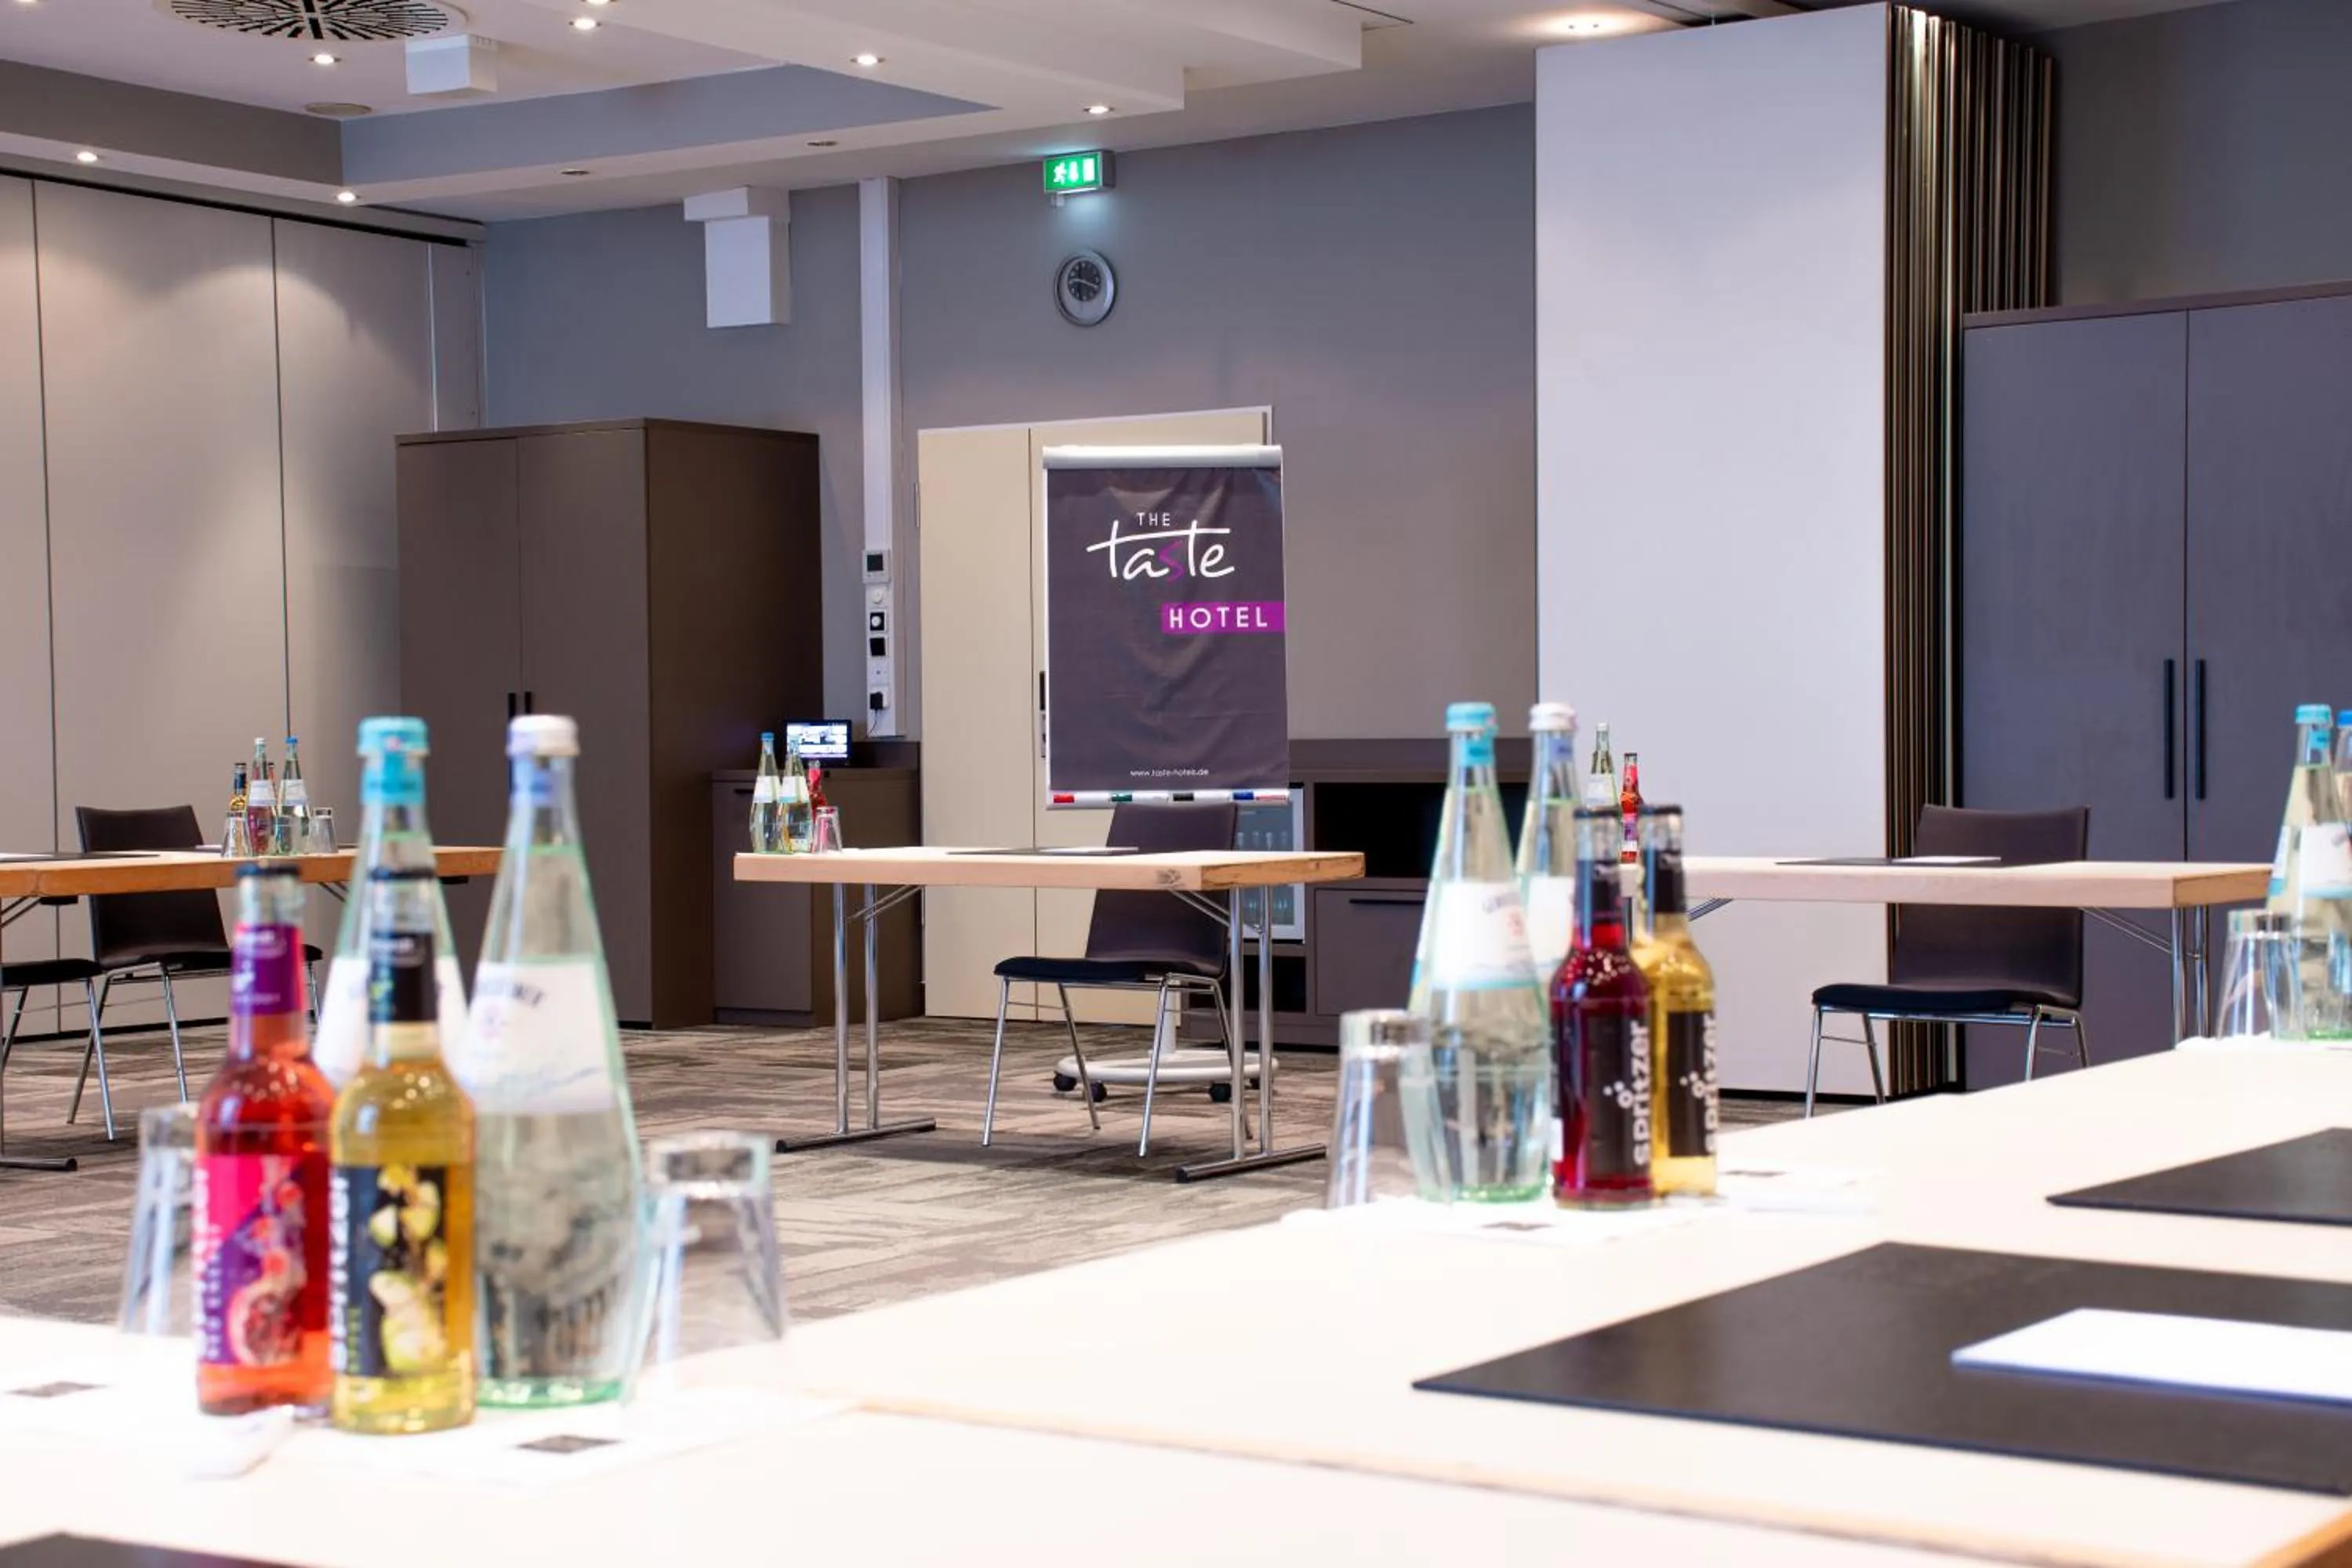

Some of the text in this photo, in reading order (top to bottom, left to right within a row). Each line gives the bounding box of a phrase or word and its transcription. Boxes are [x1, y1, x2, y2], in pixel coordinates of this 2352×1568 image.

[1136, 512, 1171, 527] THE
[1087, 519, 1236, 583] taste
[1170, 606, 1268, 629] HOTEL
[1617, 1020, 1650, 1166] spritzer
